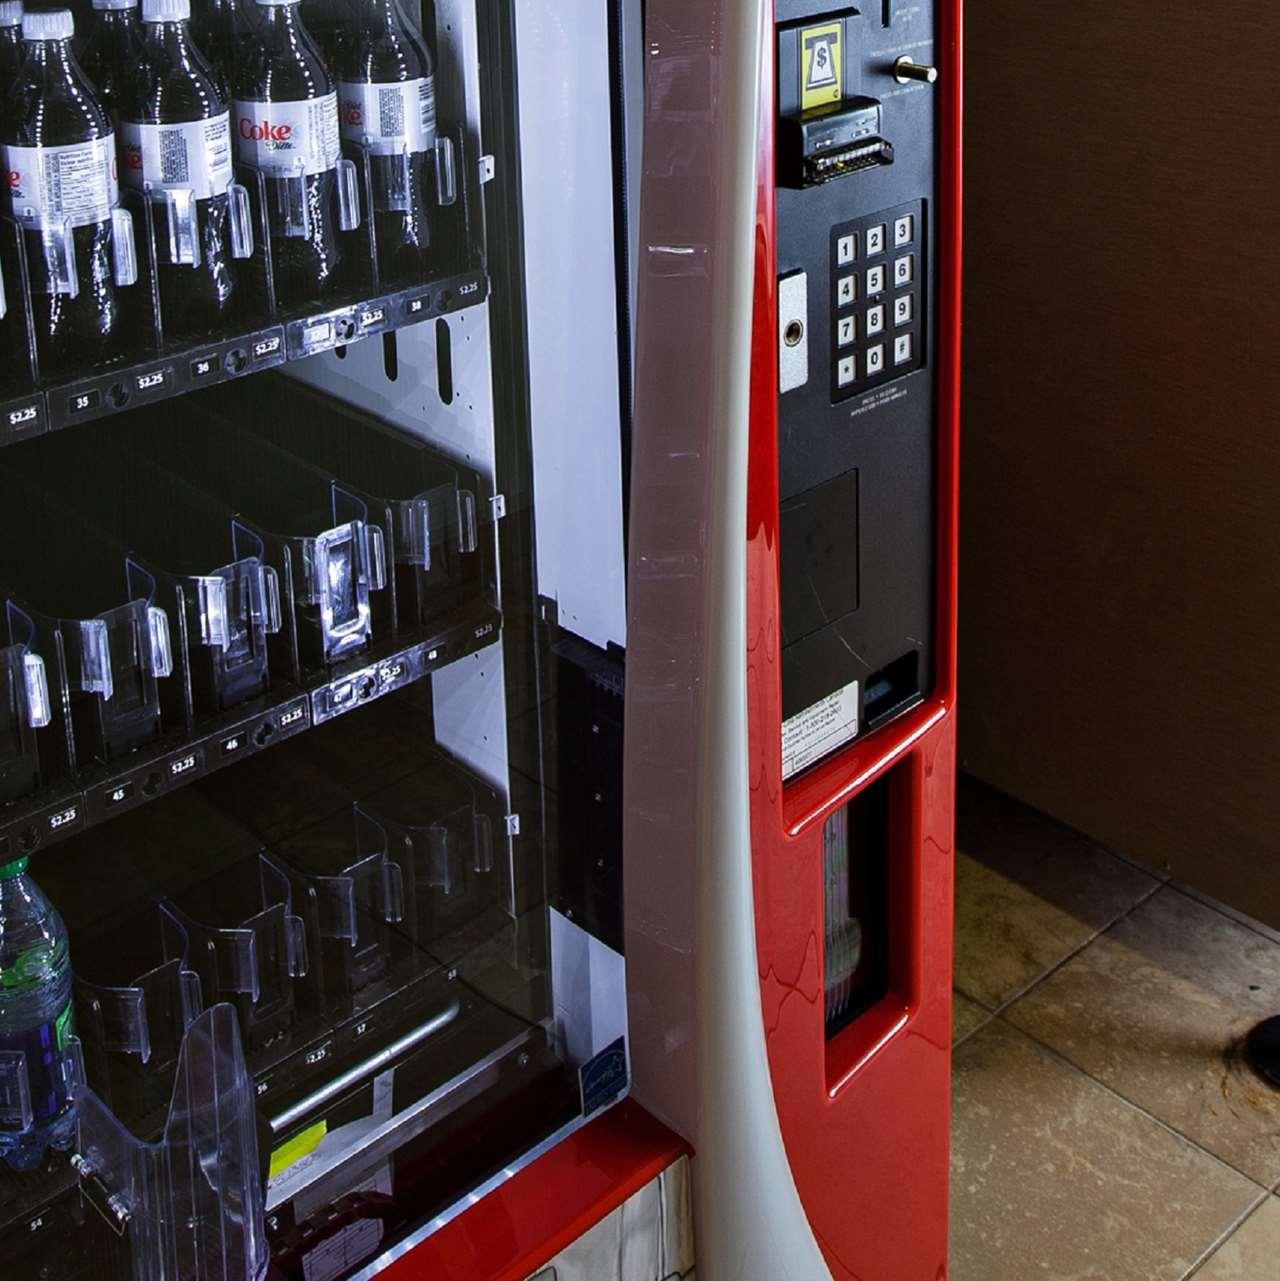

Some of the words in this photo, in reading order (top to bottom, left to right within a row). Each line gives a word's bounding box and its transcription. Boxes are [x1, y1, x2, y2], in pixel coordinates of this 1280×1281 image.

[240, 118, 291, 141] Coke
[899, 224, 906, 237] 3
[871, 234, 878, 247] 2
[899, 264, 906, 277] 6
[871, 273, 878, 286] 5
[459, 282, 478, 296] $2.25
[842, 283, 850, 296] 4
[899, 303, 906, 315] 9
[362, 310, 383, 324] $2.25
[871, 313, 878, 327] 8
[843, 324, 850, 337] 7
[255, 341, 279, 356] $2.25
[871, 352, 878, 365] 0
[197, 362, 209, 373] 36
[138, 374, 163, 389] $2.25
[76, 396, 89, 409] 35
[9, 407, 37, 424] $2.25
[428, 649, 437, 661] 48
[281, 709, 303, 725] $2.25
[226, 738, 238, 750] 46
[172, 757, 194, 774] $2.25
[112, 789, 125, 802] 45
[50, 809, 76, 828] $2.25
[257, 1083, 268, 1096] 56
[30, 1218, 43, 1231] 54
